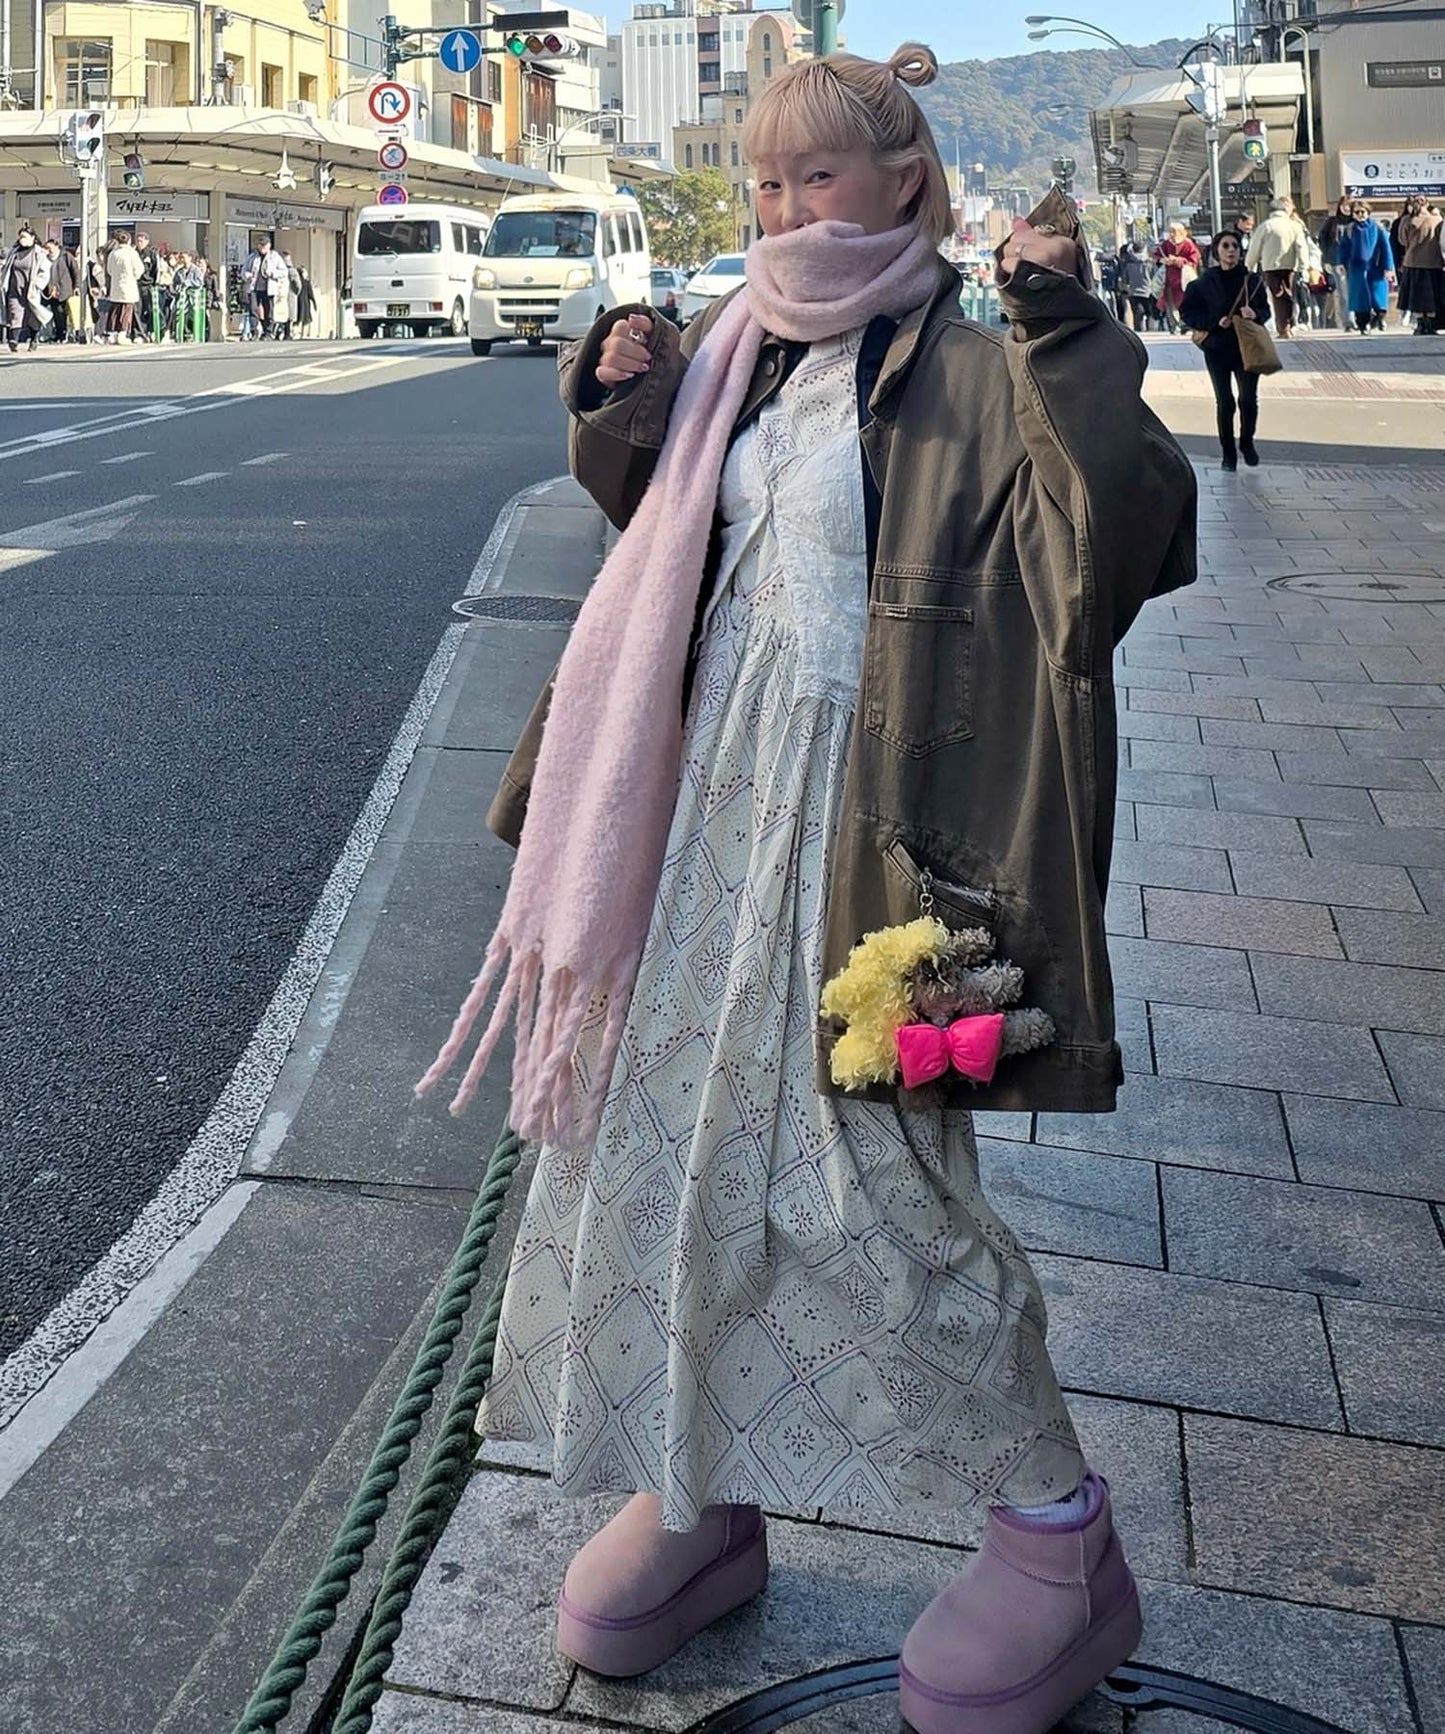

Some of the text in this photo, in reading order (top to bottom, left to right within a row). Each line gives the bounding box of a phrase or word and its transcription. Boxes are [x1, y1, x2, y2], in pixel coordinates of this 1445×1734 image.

[116, 200, 173, 213] マツモトキヨシ
